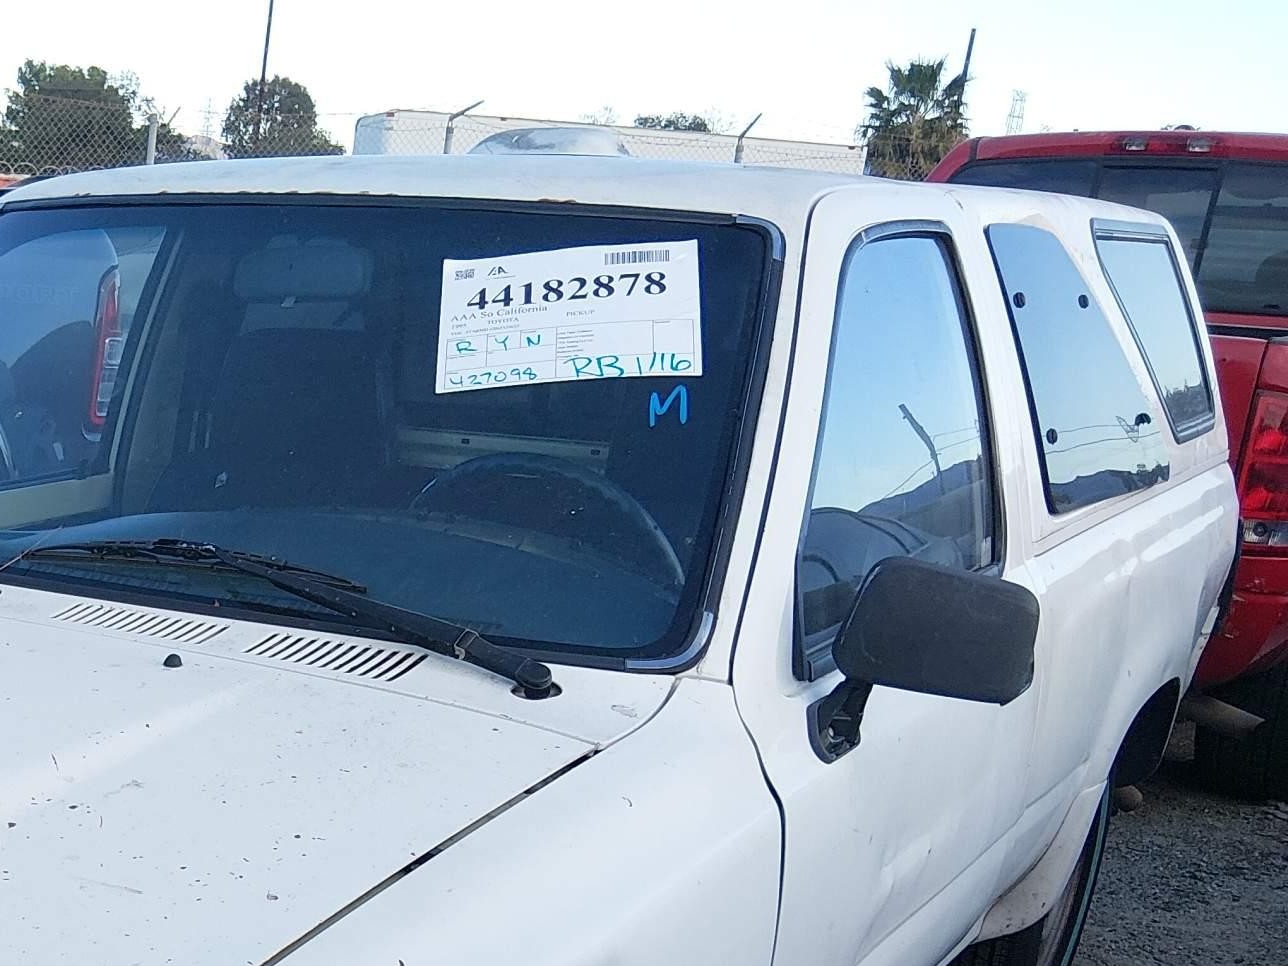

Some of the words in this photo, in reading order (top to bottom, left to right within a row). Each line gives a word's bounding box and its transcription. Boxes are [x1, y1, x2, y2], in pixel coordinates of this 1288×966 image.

[466, 271, 667, 310] 44182878
[450, 312, 477, 322] AAA
[480, 310, 494, 318] So
[496, 305, 548, 317] California
[487, 317, 520, 325] TOYOTA
[455, 341, 478, 354] R
[494, 335, 511, 351] Y
[526, 333, 542, 347] N
[648, 383, 689, 428] M
